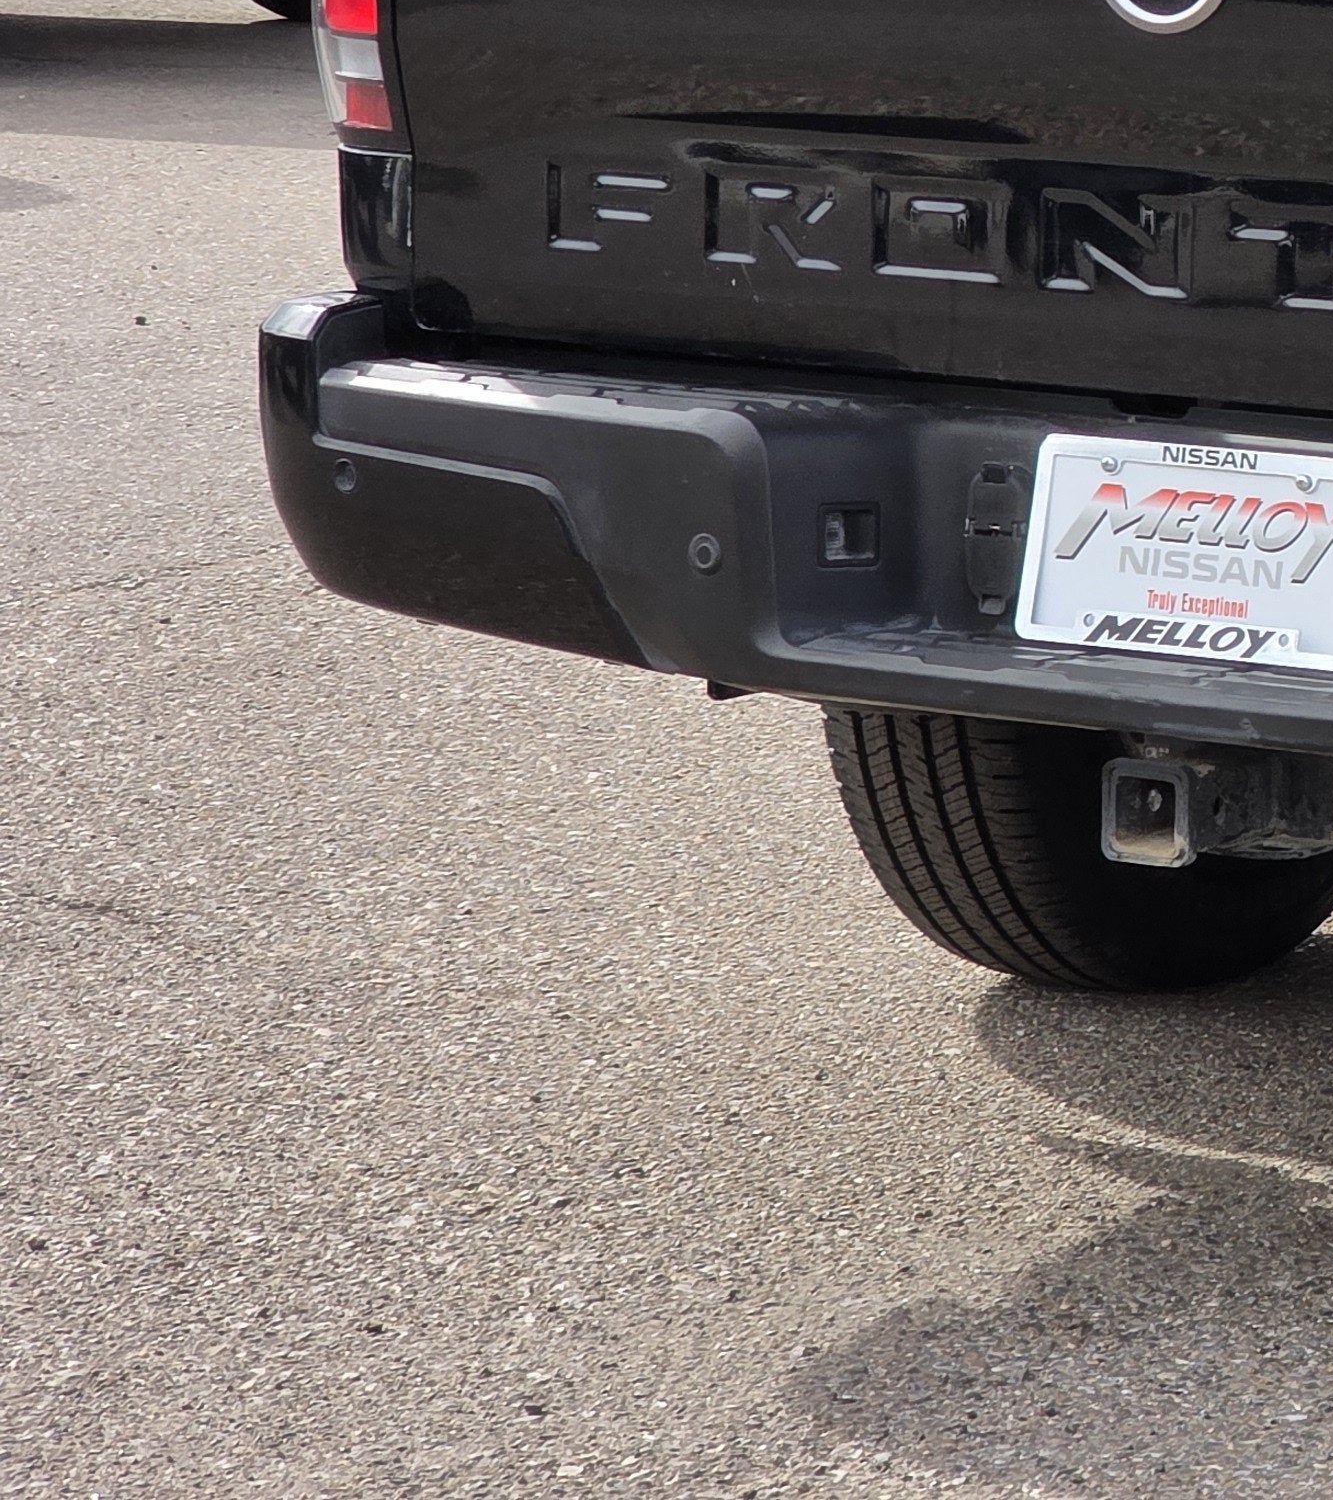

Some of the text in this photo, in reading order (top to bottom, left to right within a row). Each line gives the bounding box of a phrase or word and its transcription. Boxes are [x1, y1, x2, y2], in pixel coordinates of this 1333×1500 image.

[1161, 445, 1259, 470] NISSAN
[1118, 546, 1284, 590] NISSAN
[1146, 589, 1250, 619] Truly Exceptional
[1083, 613, 1279, 659] MELLOY
